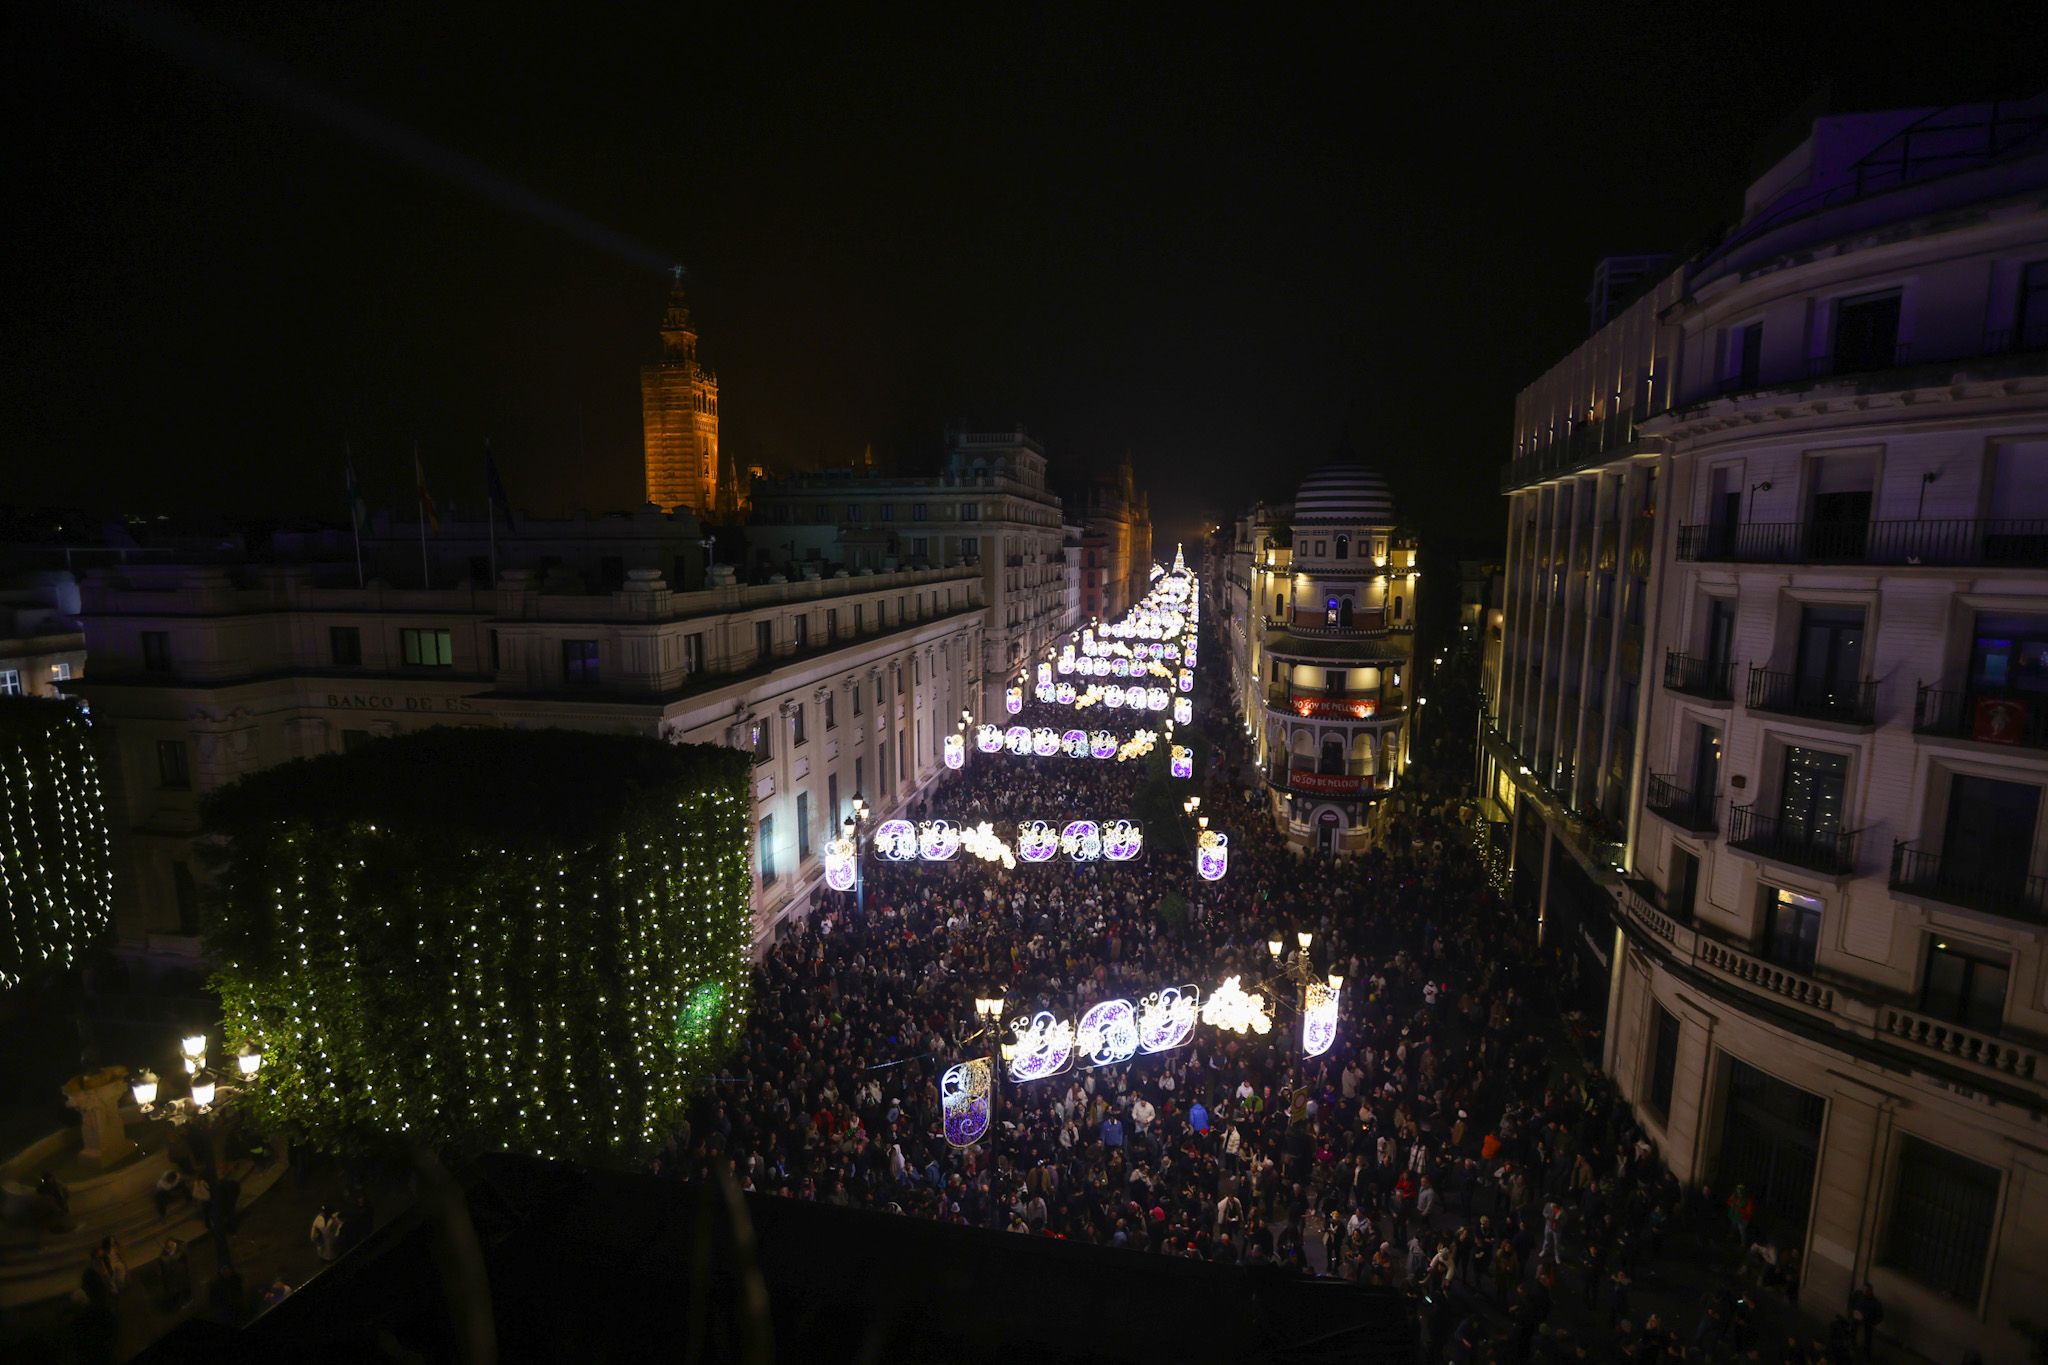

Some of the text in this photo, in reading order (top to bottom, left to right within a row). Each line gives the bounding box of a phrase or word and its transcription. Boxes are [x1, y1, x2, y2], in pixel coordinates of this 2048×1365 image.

[327, 694, 473, 713] BANCO DE ES
[1293, 700, 1303, 709] YO
[1305, 700, 1319, 710] SOY
[1292, 774, 1301, 782] YO
[1302, 775, 1317, 785] SOY
